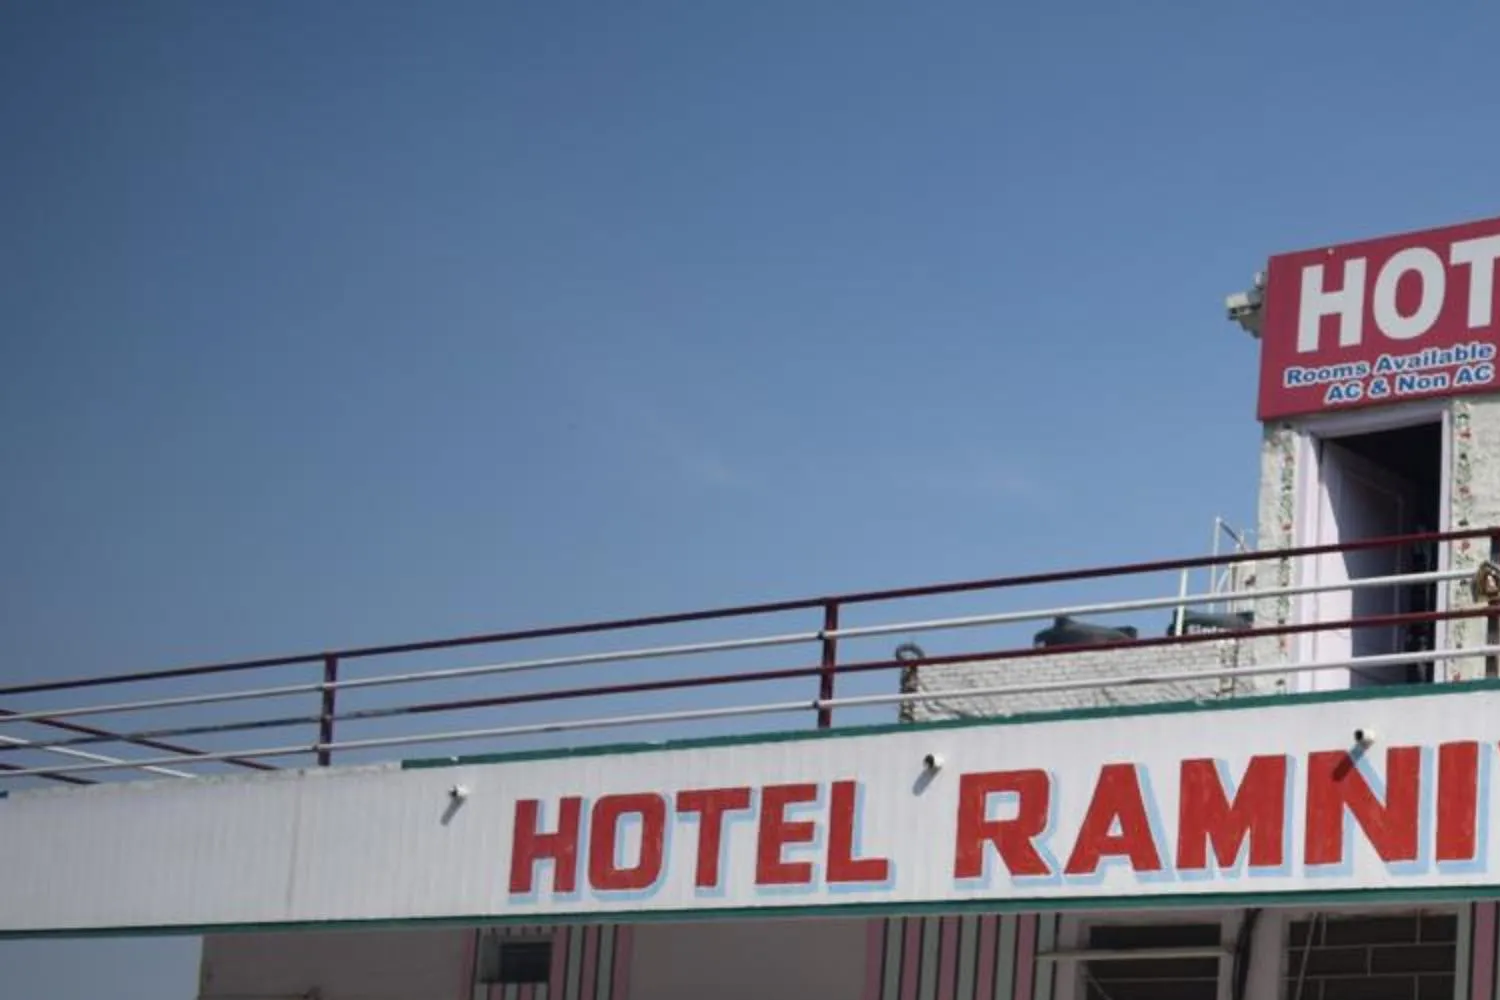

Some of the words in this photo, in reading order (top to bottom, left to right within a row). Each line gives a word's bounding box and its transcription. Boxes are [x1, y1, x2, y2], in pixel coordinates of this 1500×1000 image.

[1283, 359, 1368, 388] Rooms
[1376, 341, 1496, 377] Available
[1324, 379, 1362, 402] AC
[1367, 376, 1388, 398] &
[1398, 369, 1449, 393] Non
[1453, 362, 1494, 387] AC
[508, 778, 897, 902] HOTEL
